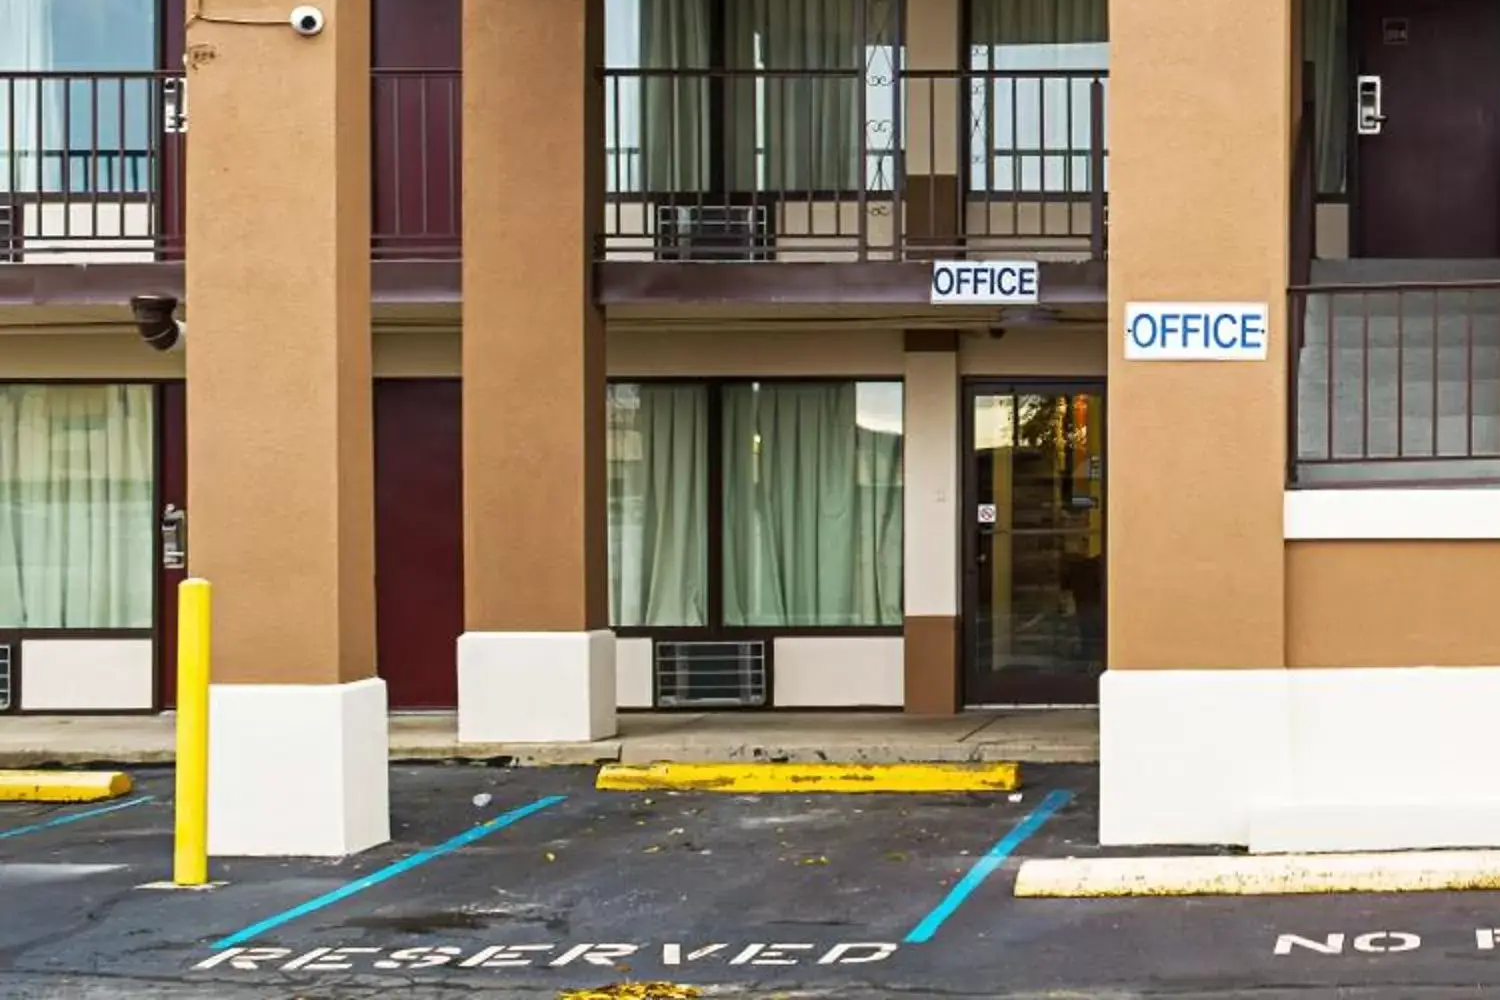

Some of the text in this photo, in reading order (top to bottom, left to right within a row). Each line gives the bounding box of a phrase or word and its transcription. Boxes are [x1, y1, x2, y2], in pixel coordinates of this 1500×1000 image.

[932, 266, 1036, 296] OFFICE
[1130, 312, 1263, 349] OFFICE
[190, 941, 899, 971] RESERVED
[1272, 930, 1422, 955] NO
